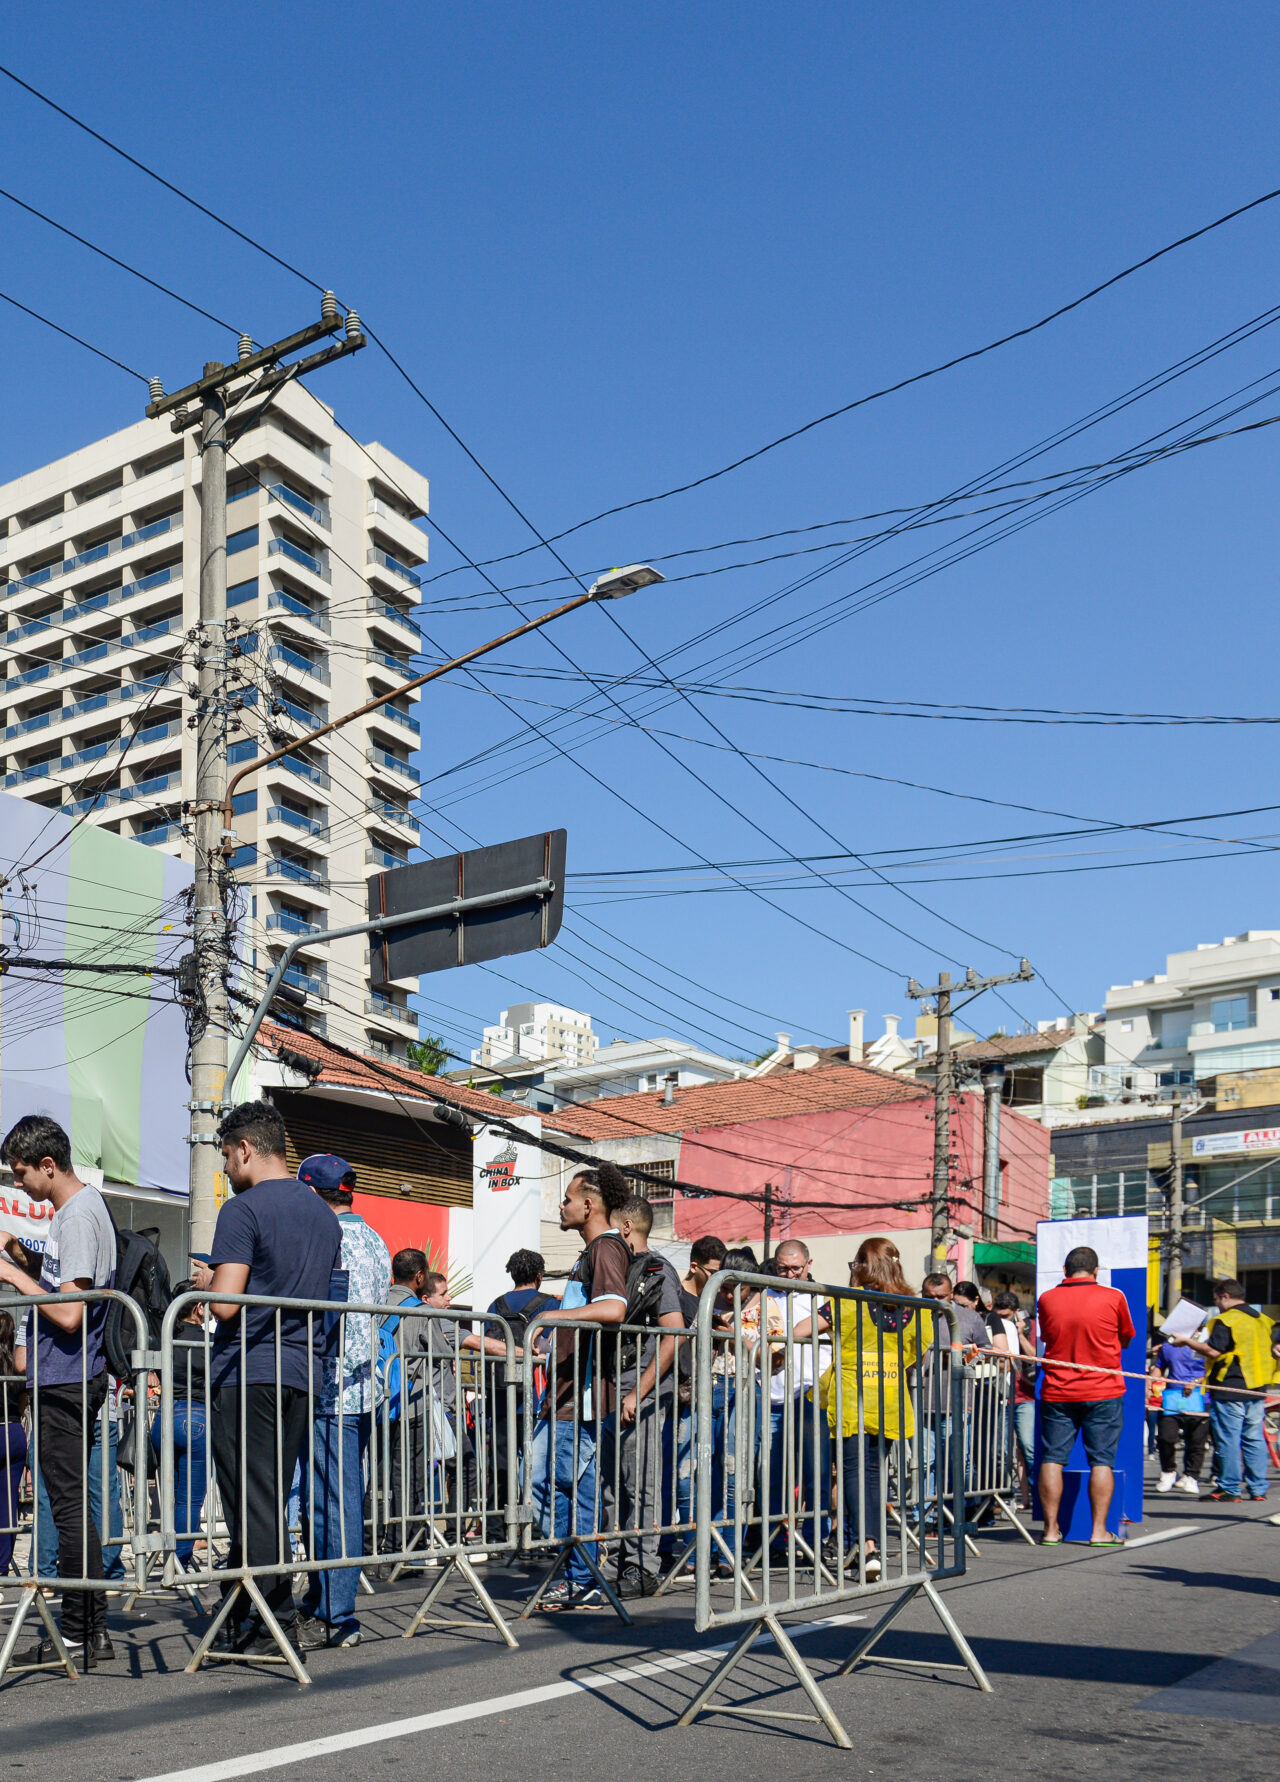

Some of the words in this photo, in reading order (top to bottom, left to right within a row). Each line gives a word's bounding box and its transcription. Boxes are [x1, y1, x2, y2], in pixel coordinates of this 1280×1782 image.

[479, 1166, 509, 1178] CHINA
[488, 1179, 499, 1188] IN
[500, 1177, 520, 1187] BOX
